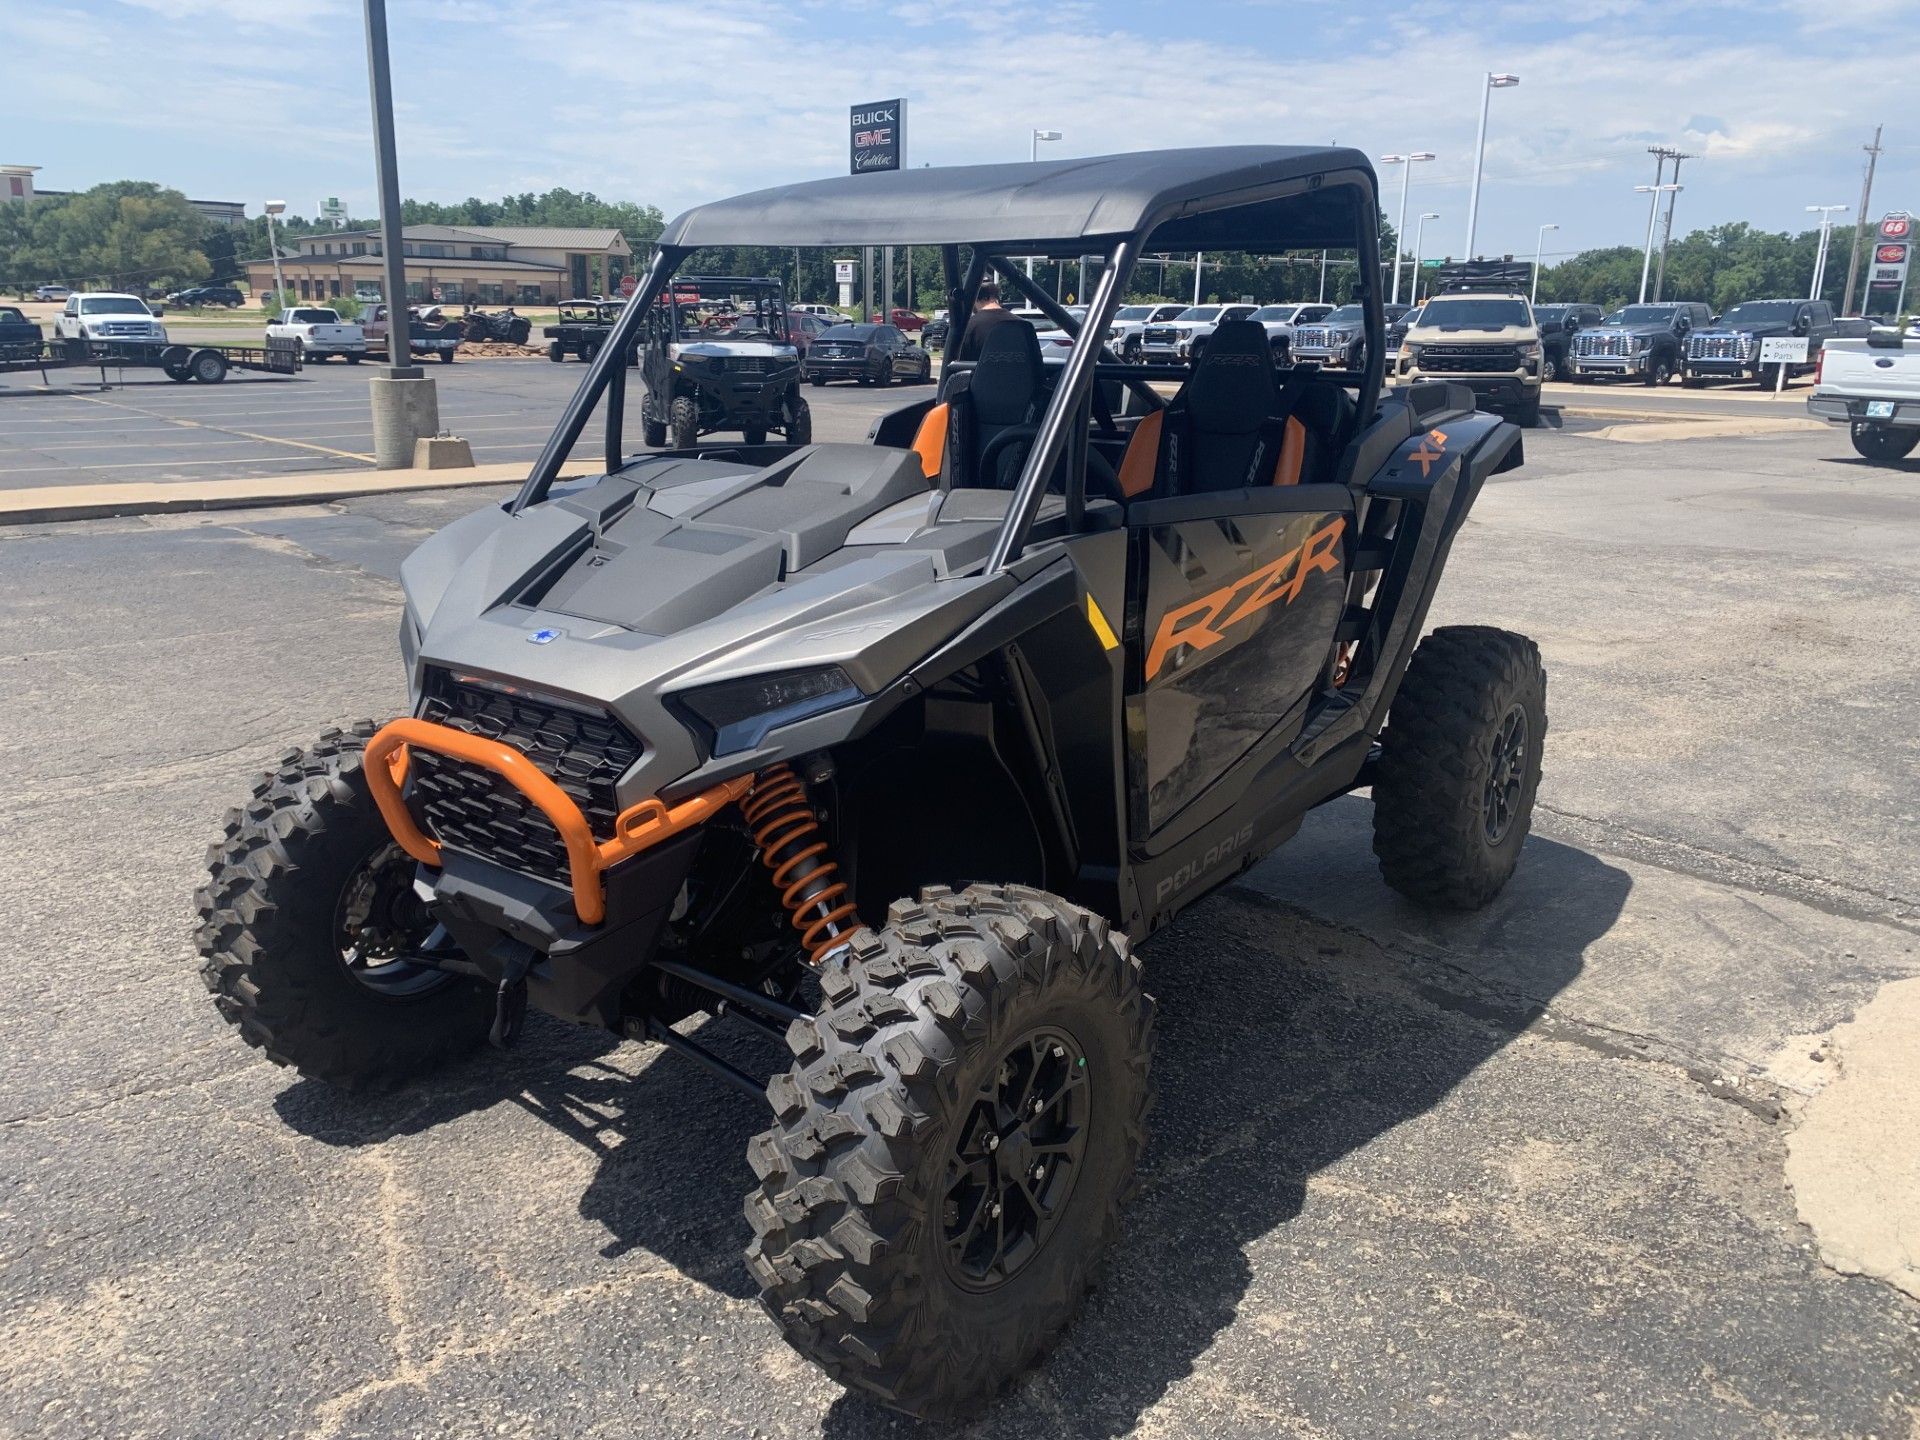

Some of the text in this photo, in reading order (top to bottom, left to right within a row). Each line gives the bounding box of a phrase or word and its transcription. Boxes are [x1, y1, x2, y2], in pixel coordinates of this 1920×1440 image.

[852, 109, 895, 126] BUICK
[855, 128, 891, 147] GMC
[1885, 222, 1904, 233] 66
[1775, 341, 1806, 350] Service
[1773, 352, 1793, 360] Parts
[1145, 517, 1346, 683] RZR
[1156, 821, 1254, 905] POLARIS
